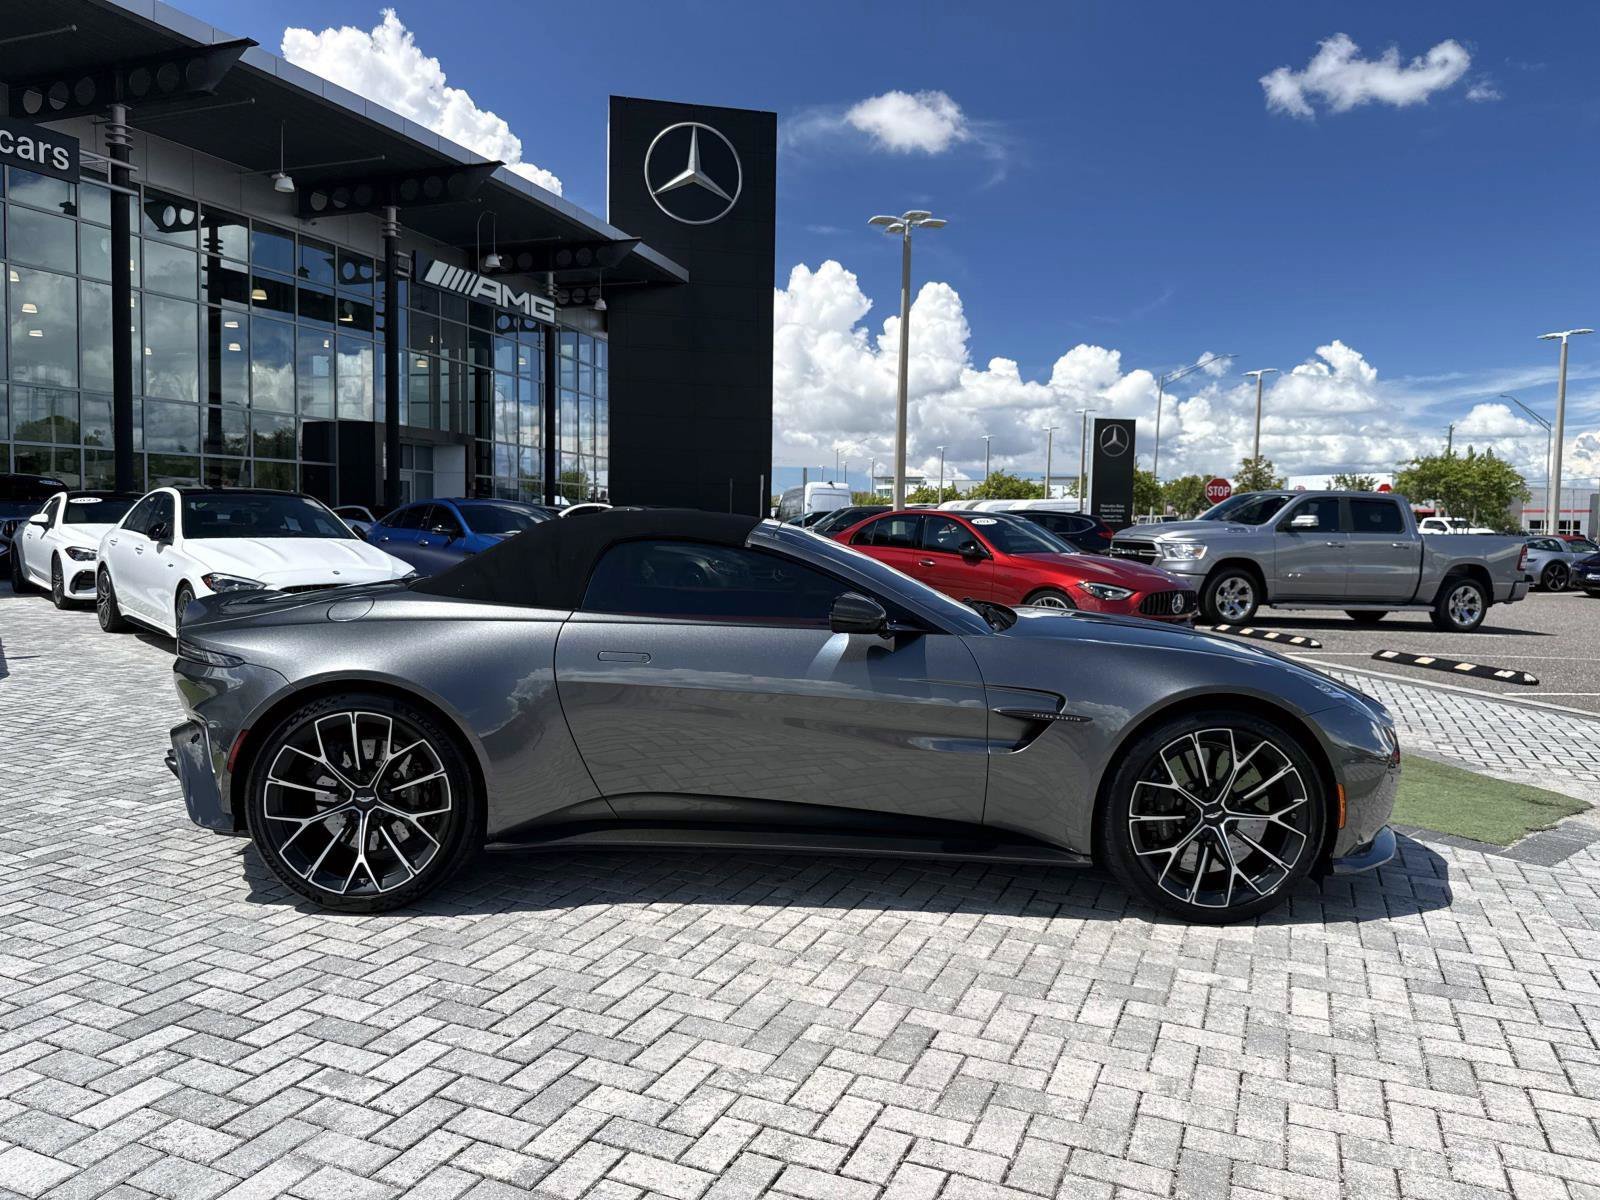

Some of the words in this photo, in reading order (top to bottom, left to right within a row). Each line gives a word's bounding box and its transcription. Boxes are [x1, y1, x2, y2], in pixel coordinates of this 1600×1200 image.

[0, 129, 70, 170] cars
[470, 275, 555, 323] AMG
[1207, 486, 1230, 496] STOP
